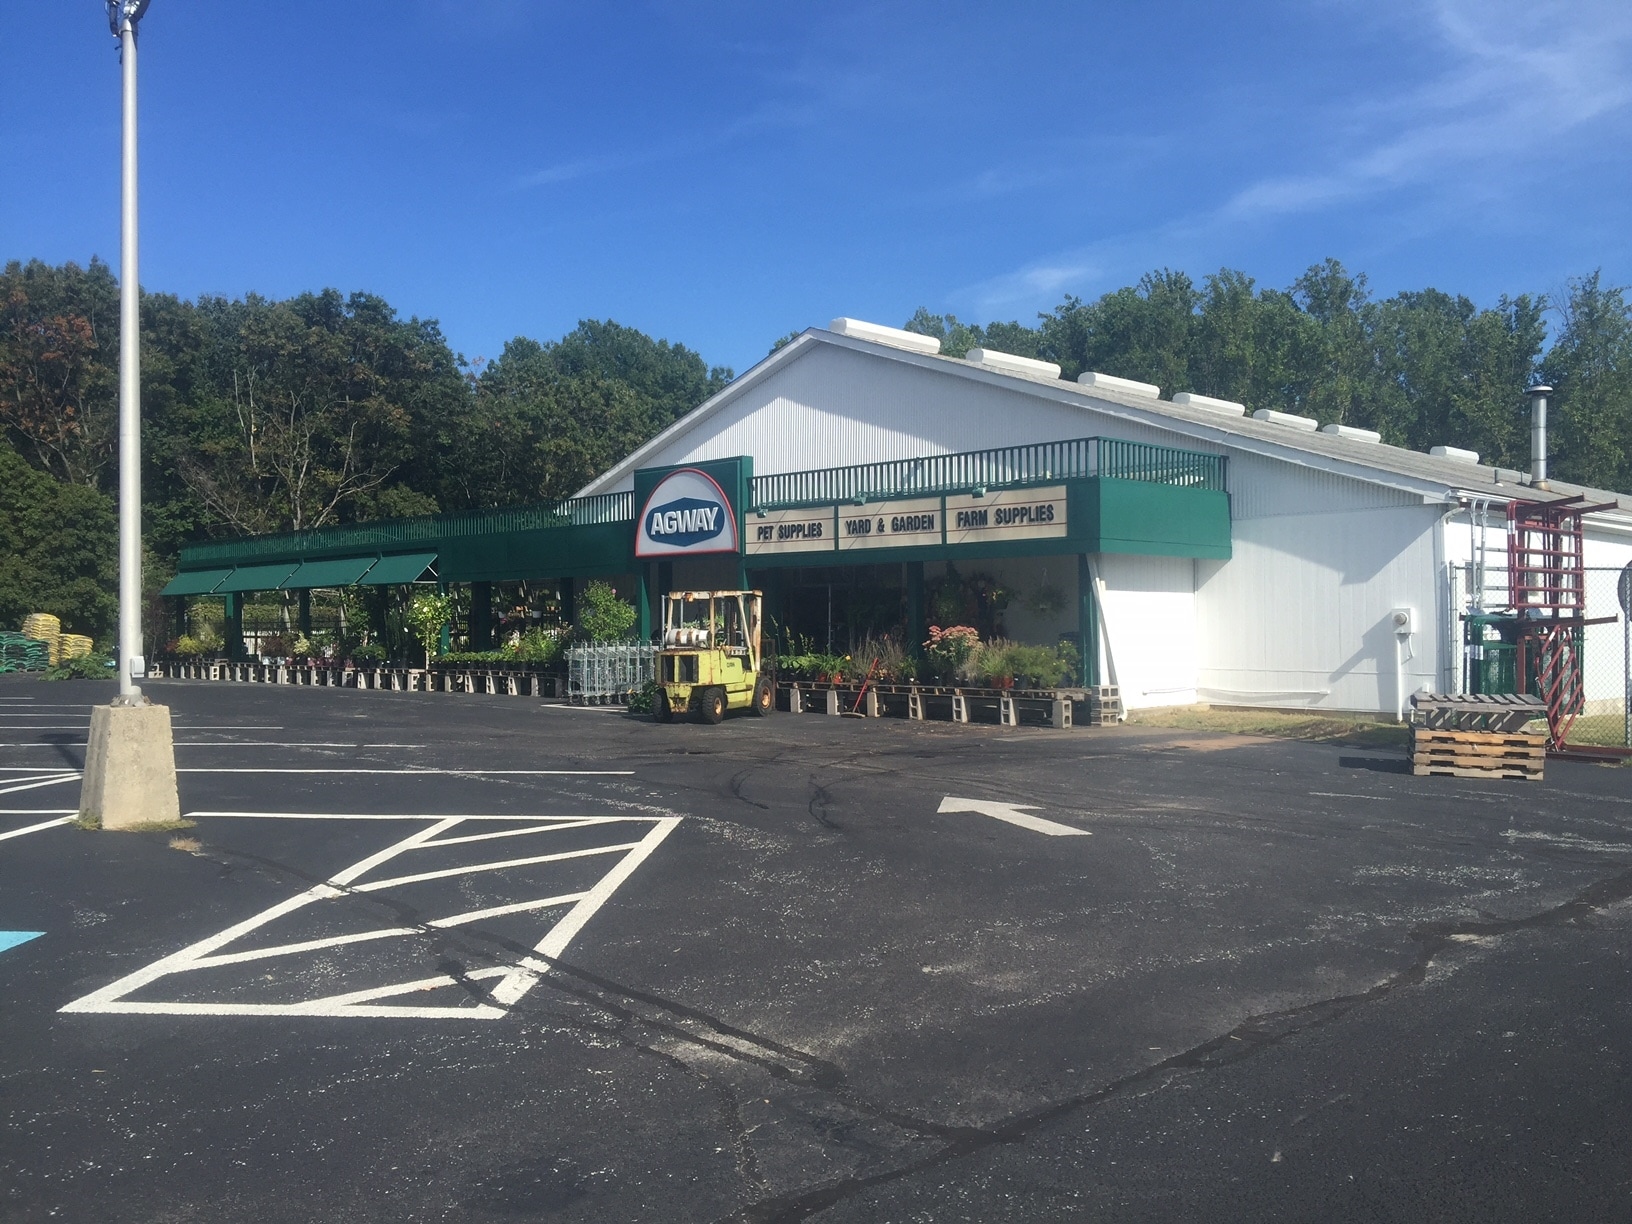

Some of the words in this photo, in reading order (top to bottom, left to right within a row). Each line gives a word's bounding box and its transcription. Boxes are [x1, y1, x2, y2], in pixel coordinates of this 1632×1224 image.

[651, 507, 718, 535] AGWAY
[846, 519, 871, 535] YARD
[877, 518, 885, 533] &
[892, 514, 934, 532] GARDEN
[957, 510, 988, 528] FARM
[995, 504, 1054, 523] SUPPLIES
[758, 526, 774, 541] PET
[779, 522, 823, 539] SUPPLIES
